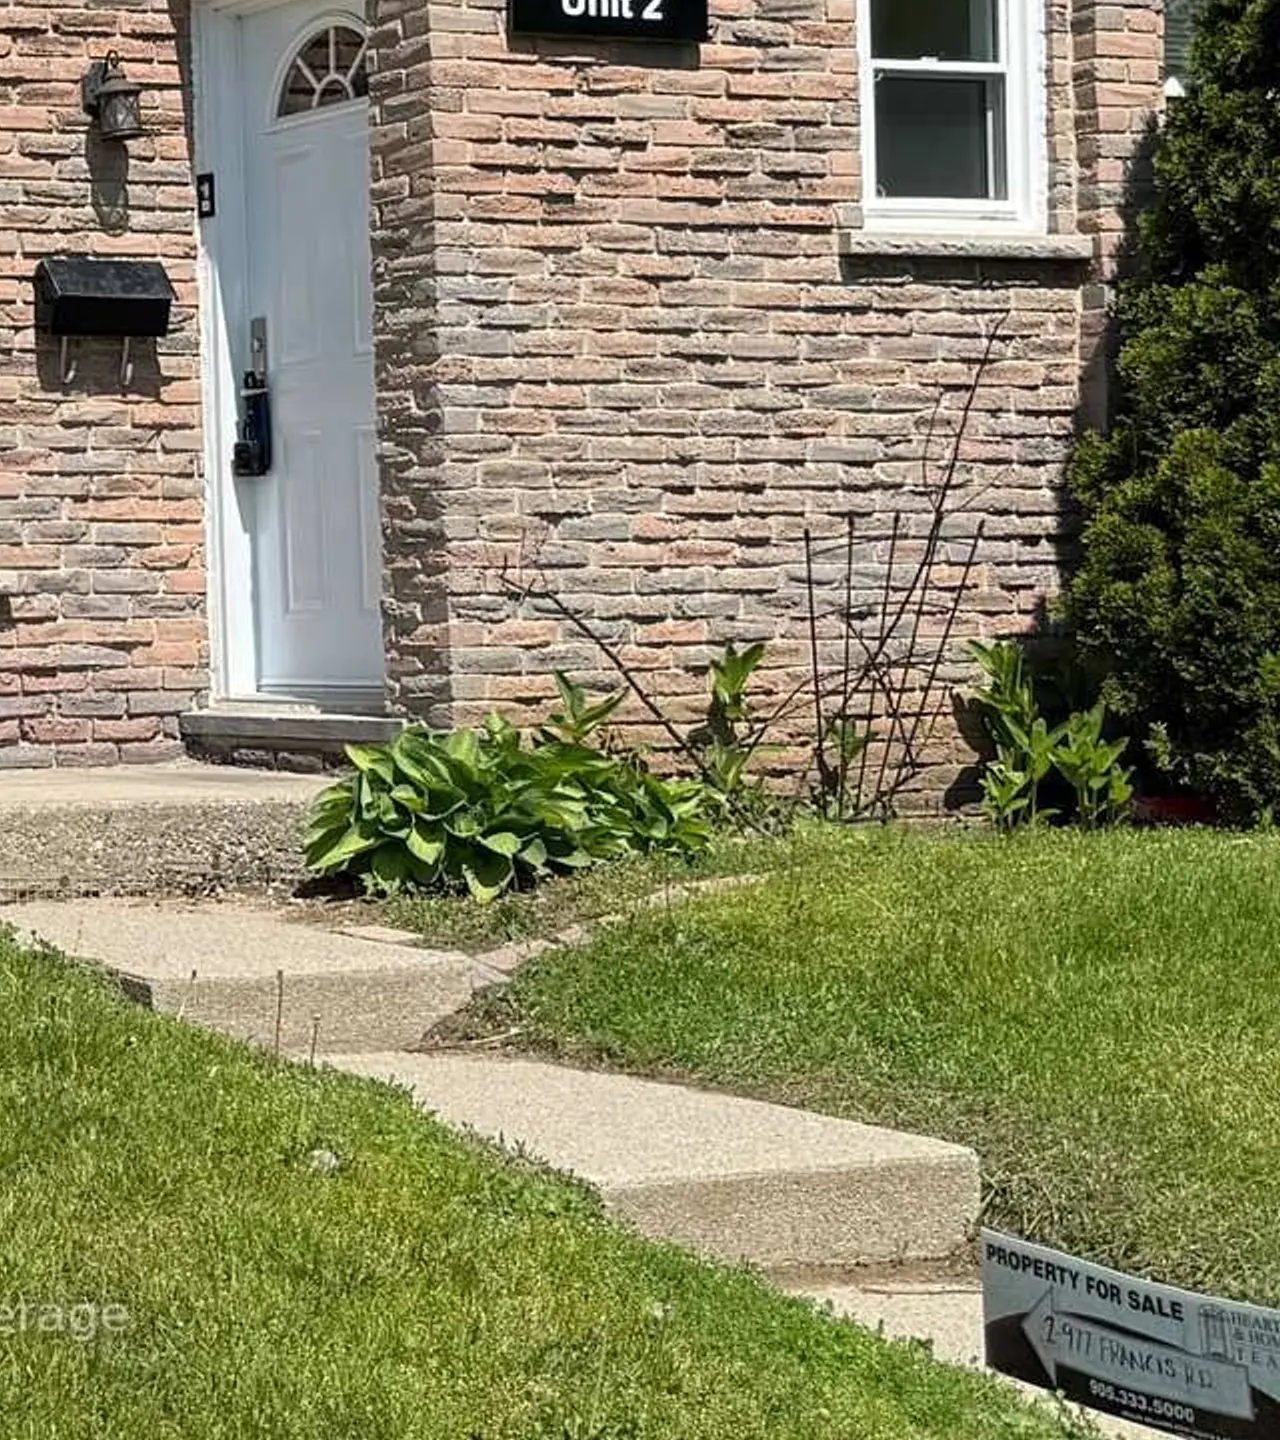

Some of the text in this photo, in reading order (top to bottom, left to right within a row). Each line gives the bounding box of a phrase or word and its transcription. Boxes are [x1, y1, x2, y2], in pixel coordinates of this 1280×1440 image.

[985, 1243, 1185, 1322] PROPERTY FOR SALE
[1089, 1379, 1196, 1424] 905.333.5000
